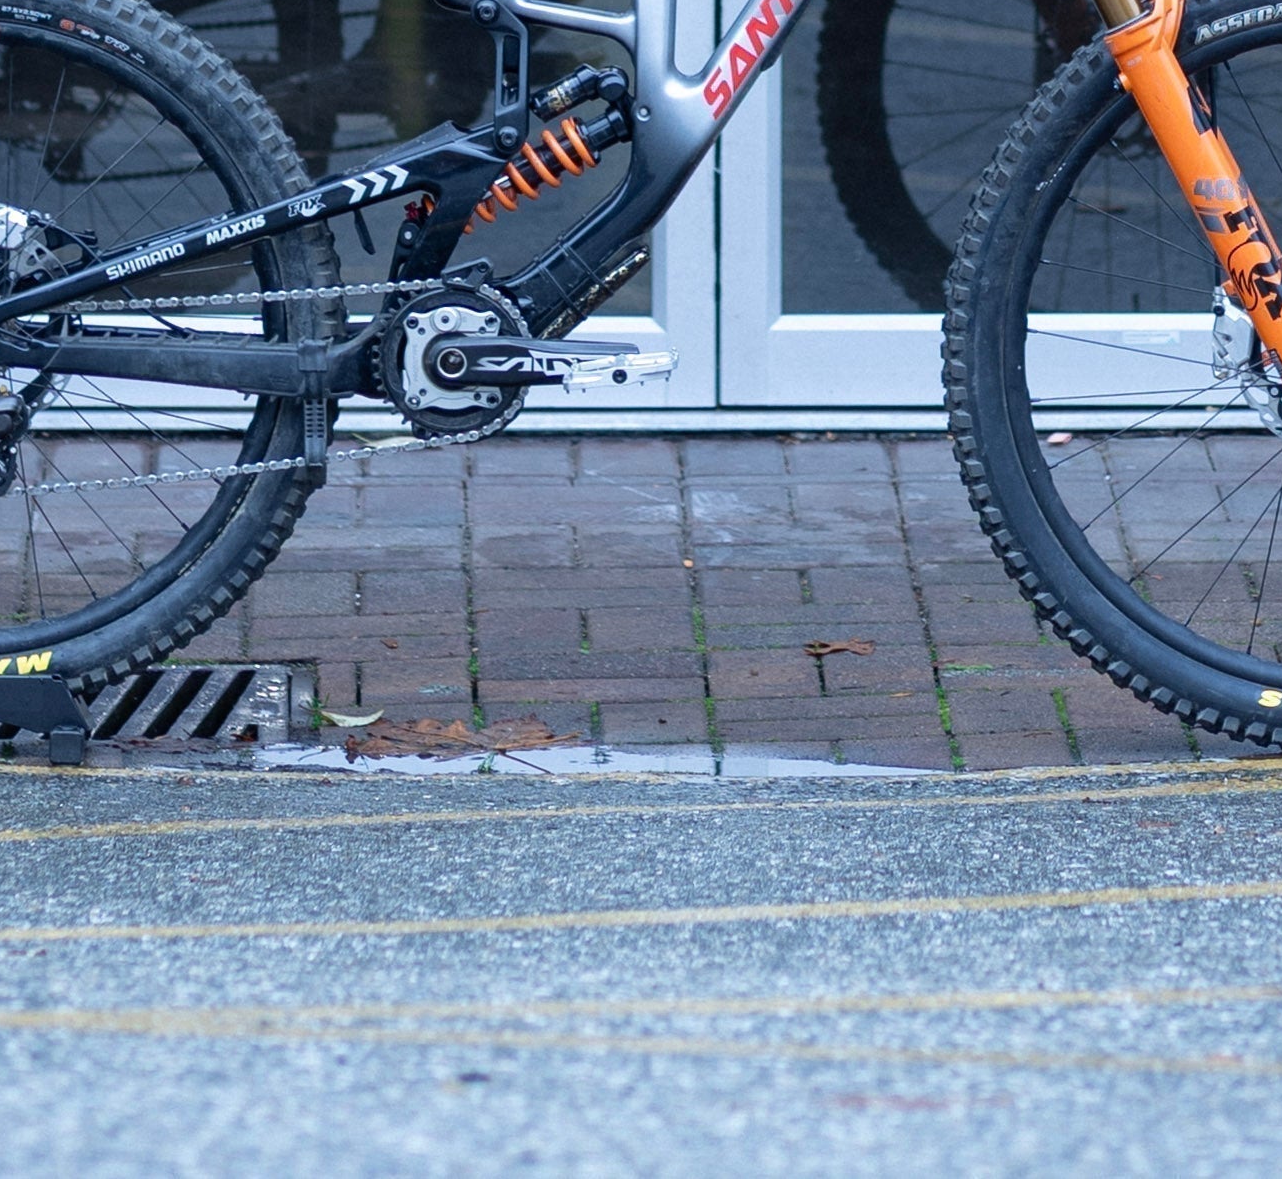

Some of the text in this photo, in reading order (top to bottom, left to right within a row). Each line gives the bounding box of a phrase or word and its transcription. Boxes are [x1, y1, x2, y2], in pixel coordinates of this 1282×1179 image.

[105, 242, 186, 281] SHIMANO
[205, 214, 266, 246] MAXXIS
[287, 194, 326, 218] FOX
